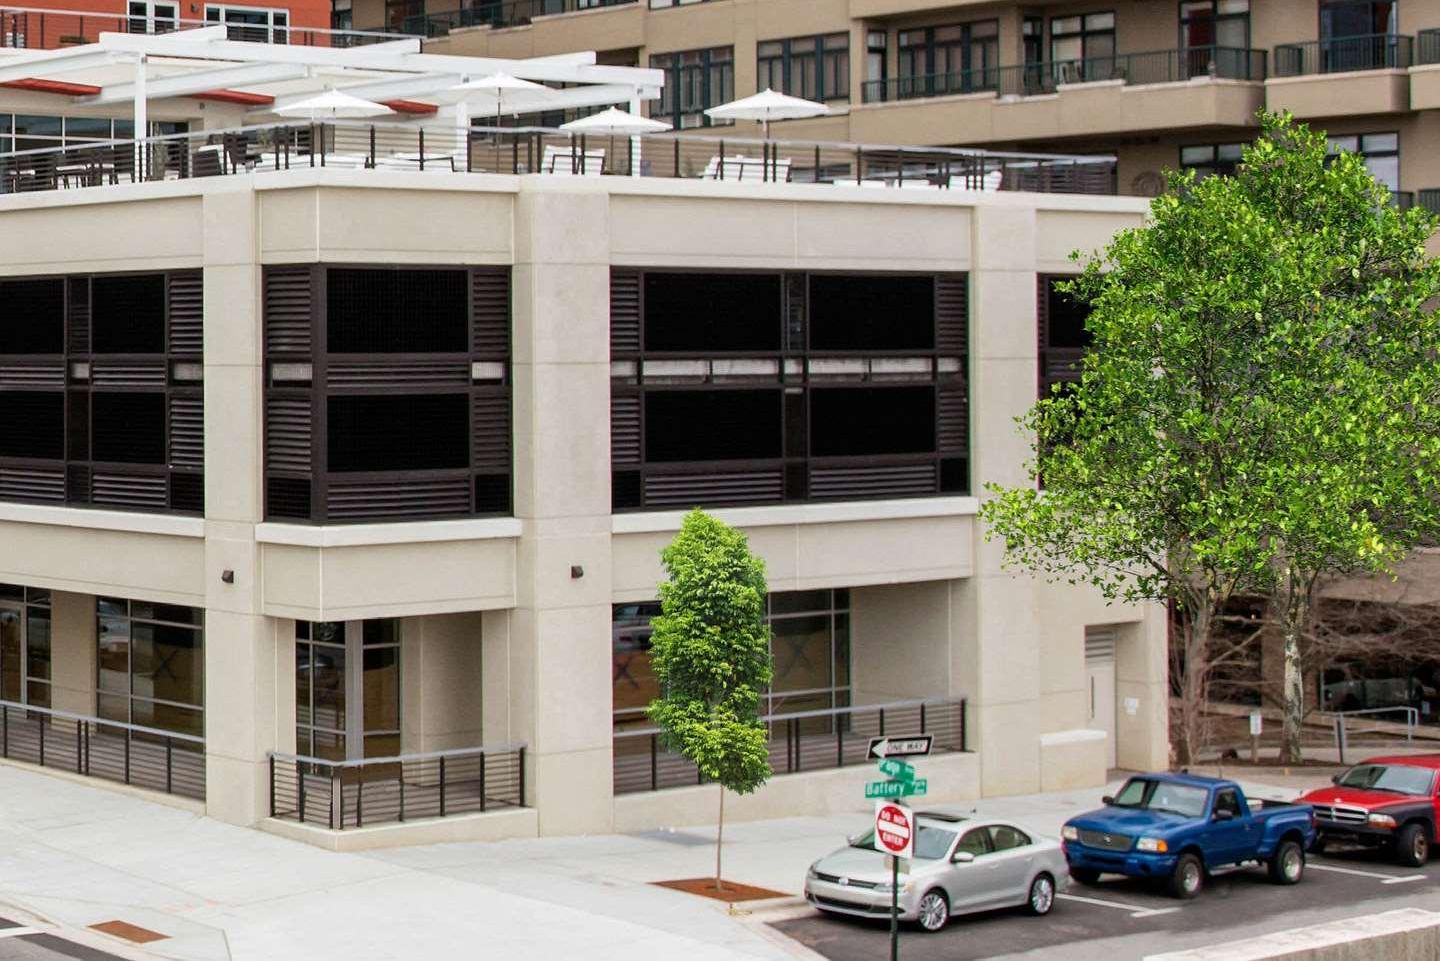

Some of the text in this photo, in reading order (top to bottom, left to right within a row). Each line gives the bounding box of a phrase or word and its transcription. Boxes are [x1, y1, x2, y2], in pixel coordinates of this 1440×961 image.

[886, 740, 926, 754] ONE WAY
[866, 782, 904, 797] Battery
[881, 810, 906, 826] DO NOT
[882, 832, 904, 847] ENTER
